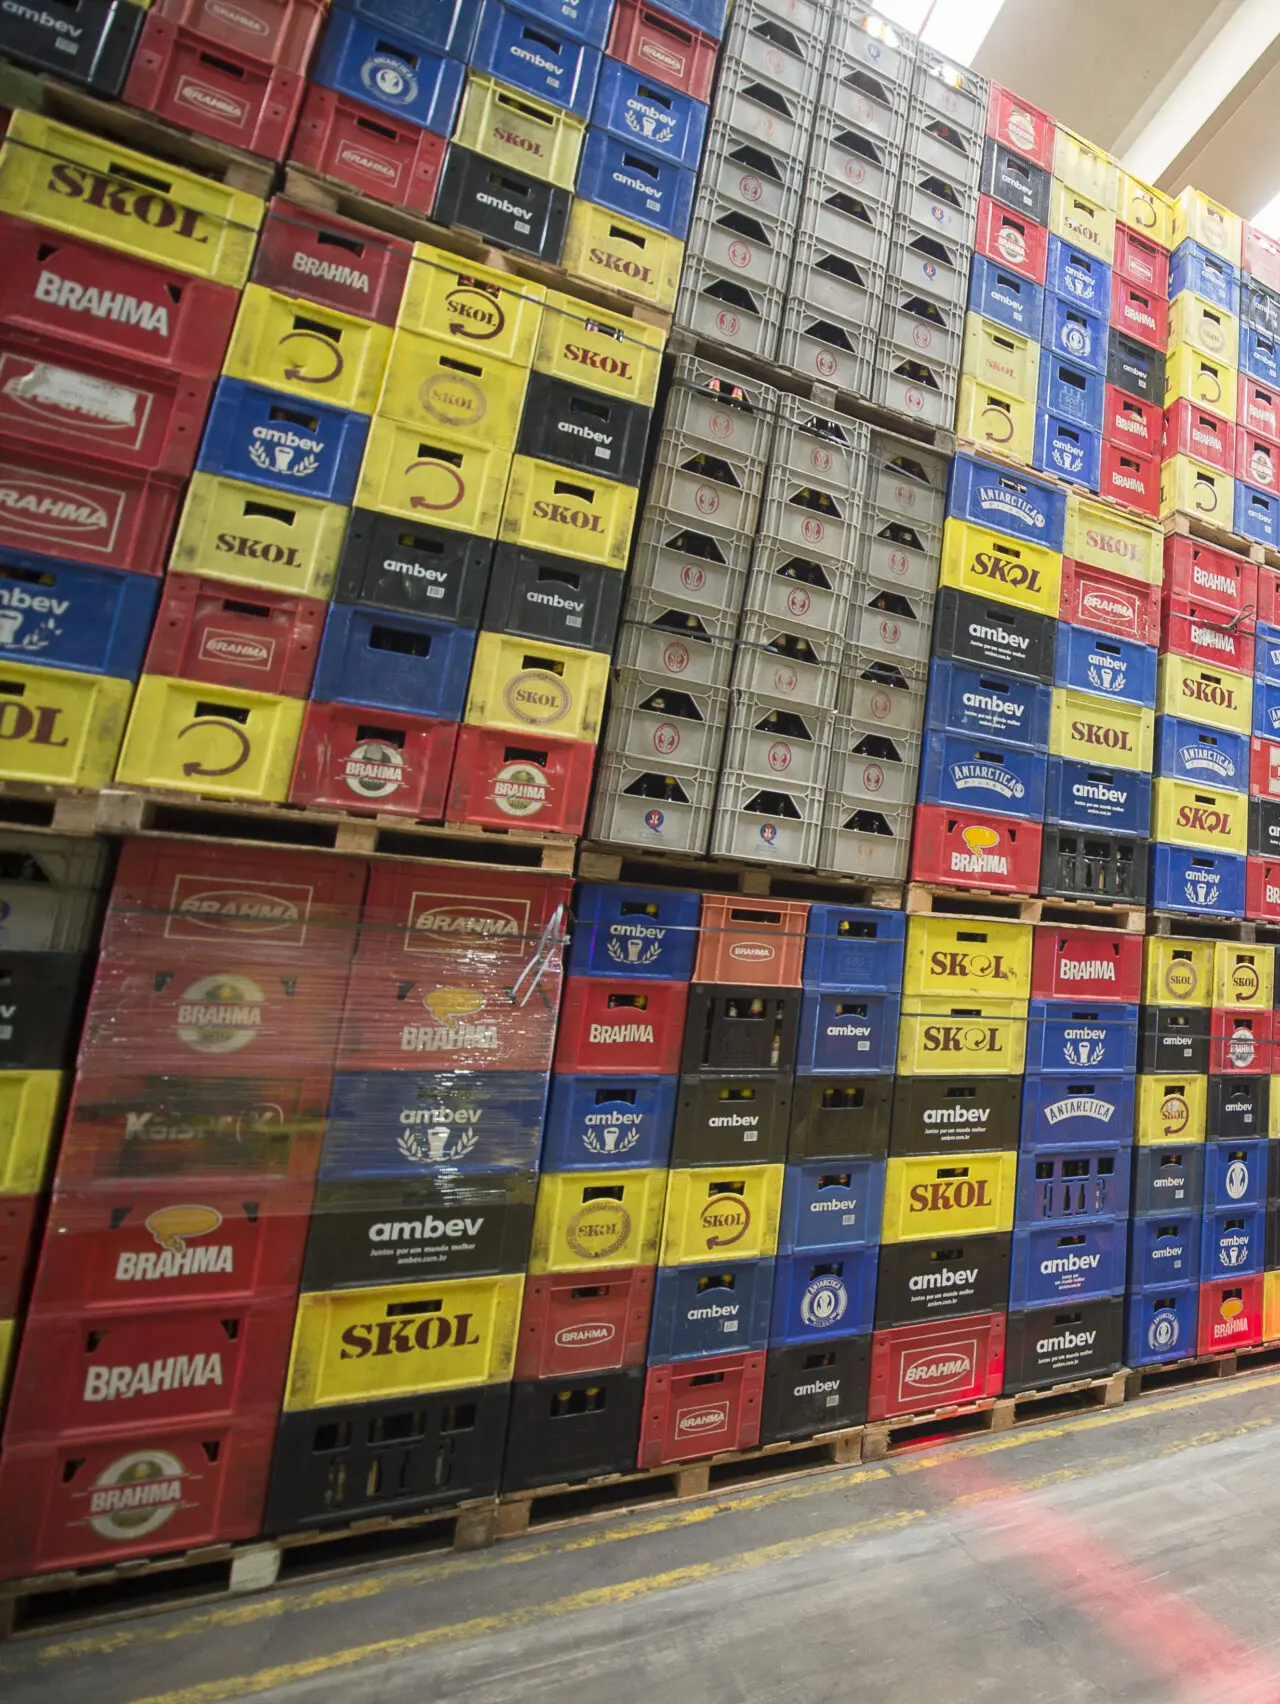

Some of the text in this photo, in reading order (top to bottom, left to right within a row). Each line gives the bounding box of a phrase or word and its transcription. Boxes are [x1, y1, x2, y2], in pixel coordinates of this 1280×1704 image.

[2, 0, 83, 37] ambev
[510, 45, 563, 75] ambev
[182, 86, 242, 116] BRAHMA
[626, 98, 676, 127] ambev
[493, 126, 544, 158] SKOL
[341, 151, 395, 179] BRAHMA
[612, 170, 662, 198] ambev
[1002, 174, 1032, 196] ambev
[48, 164, 208, 244] SKOL
[476, 191, 533, 220] ambev
[292, 252, 369, 293] BRAHMA
[589, 248, 654, 285] SKOL
[1065, 265, 1095, 285] ambev
[34, 271, 169, 336] BRAHMA
[447, 300, 496, 328] SKOL
[1124, 306, 1156, 331] BRAHMA
[564, 343, 633, 381] SKOL
[1123, 362, 1148, 379] ambev
[252, 425, 324, 453] ambev
[558, 420, 612, 446] ambev
[1052, 439, 1083, 457] ambev
[1112, 472, 1145, 495] BRAHMA
[0, 488, 107, 528] RAHMA
[980, 487, 1038, 519] ANTARCTICA
[533, 500, 605, 534] SKOL
[216, 533, 302, 569] SKOL
[383, 557, 447, 583] ambev
[970, 552, 1042, 593] SKOL
[1194, 566, 1237, 598] BRAHMA
[527, 588, 584, 612] ambev
[1084, 594, 1134, 618] BRAHMA
[969, 622, 1029, 650] ambev
[1191, 624, 1235, 654] BRAHMA
[206, 638, 268, 659] BRAHMA
[1088, 653, 1127, 672] ambev
[515, 689, 559, 709] SKOL
[963, 690, 1025, 717] ambev
[1183, 678, 1238, 711] SKOL
[1071, 721, 1133, 752] SKOL
[345, 760, 403, 782] BRAHMA
[1184, 746, 1230, 773] ANTARCTICA
[954, 765, 1016, 789] ANTARCTICA
[494, 782, 545, 802] BRAHMA
[1073, 782, 1127, 804] ambev
[951, 852, 1008, 876] BRAHMA
[1185, 869, 1220, 884] ambev
[180, 900, 299, 920] BRAHMA
[416, 913, 519, 937] BRAHMA
[610, 923, 665, 940] ambev
[734, 946, 770, 957] BRAHMA
[1060, 959, 1116, 982] BRAHMA
[1170, 976, 1191, 984] SKOL
[1233, 977, 1256, 987] SKOL
[177, 1004, 262, 1025] BRAHMA
[589, 1024, 653, 1044] BRAHMA
[827, 1024, 871, 1037] ambev
[1064, 1027, 1106, 1040] ambev
[1163, 1036, 1192, 1045] ambev
[400, 1106, 482, 1124] ambev
[923, 1105, 990, 1123] ambev
[1049, 1100, 1112, 1122] ANTARCTICA
[1225, 1102, 1252, 1112] ambev
[585, 1112, 642, 1126] ambev
[708, 1114, 759, 1128] ambev
[1154, 1177, 1184, 1187] ambev
[811, 1199, 856, 1212] ambev
[910, 1180, 992, 1212] SKOL
[368, 1215, 484, 1242] ambev
[702, 1211, 746, 1230] SKOL
[1152, 1247, 1182, 1258] ambev
[1220, 1236, 1249, 1246] ambev
[115, 1245, 233, 1281] BRAHMA
[1040, 1253, 1100, 1275] ambev
[909, 1268, 978, 1290] ambev
[687, 1304, 739, 1321] ambev
[340, 1313, 480, 1360] SKOL
[562, 1327, 608, 1342] BRAHMA
[1214, 1318, 1248, 1338] BRAHMA
[1036, 1331, 1096, 1353] ambev
[84, 1354, 222, 1401] BRAHMA
[905, 1357, 971, 1382] BRAHMA
[793, 1379, 840, 1397] ambev
[680, 1409, 725, 1428] BRAHMA
[91, 1480, 181, 1512] BRAHMA
